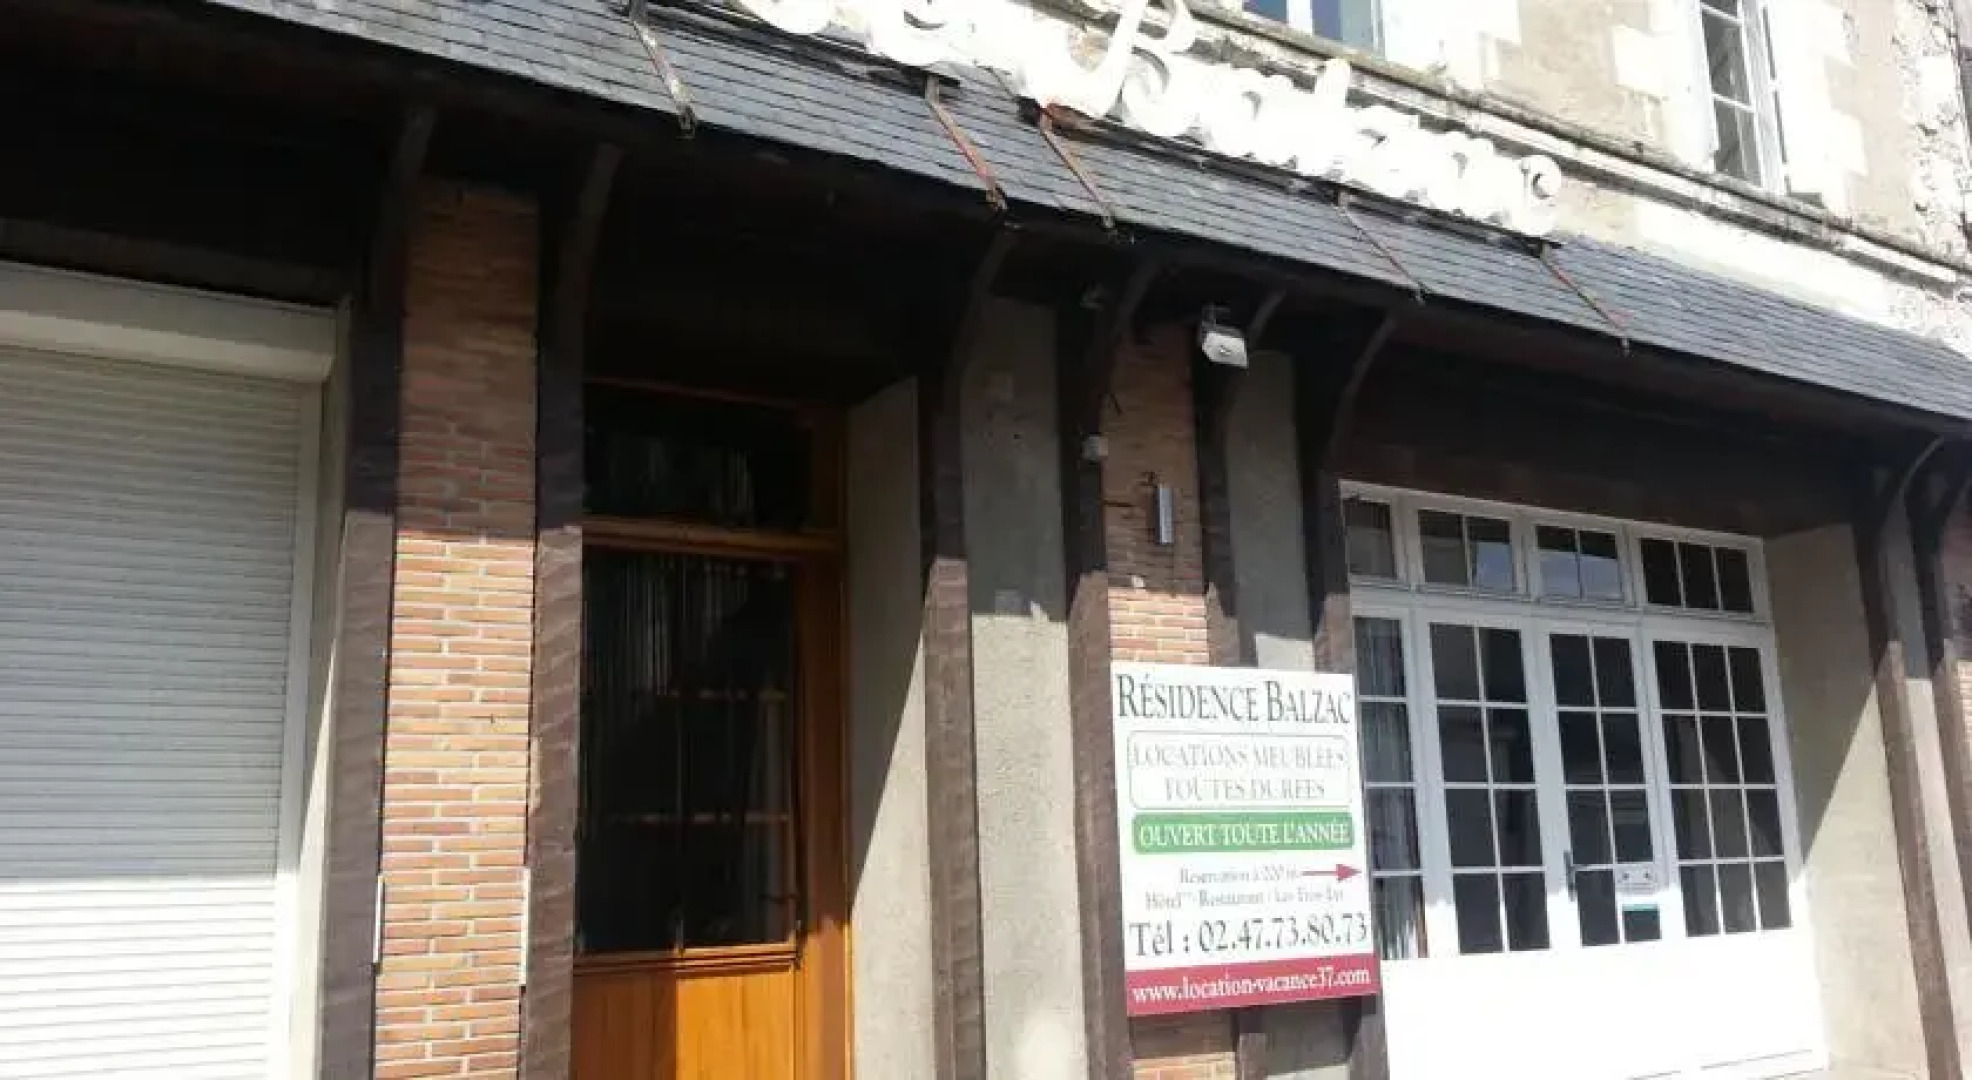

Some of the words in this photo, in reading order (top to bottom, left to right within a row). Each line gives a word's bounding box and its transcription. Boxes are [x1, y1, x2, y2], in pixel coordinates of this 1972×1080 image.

[1115, 673, 1260, 721] RÉSIDENCE
[1264, 680, 1351, 723] BALZAC
[1134, 743, 1248, 769] LOCATIONS
[1164, 777, 1245, 801] TOUTES
[1140, 823, 1217, 846] OUVERT
[1223, 823, 1278, 845] TOUTE
[1283, 816, 1351, 844] L'ANNÉE
[1128, 919, 1173, 956] Tél
[1198, 911, 1367, 953] 02.47.73.80.73
[1131, 964, 1371, 1004] www.location-vacance37.com
